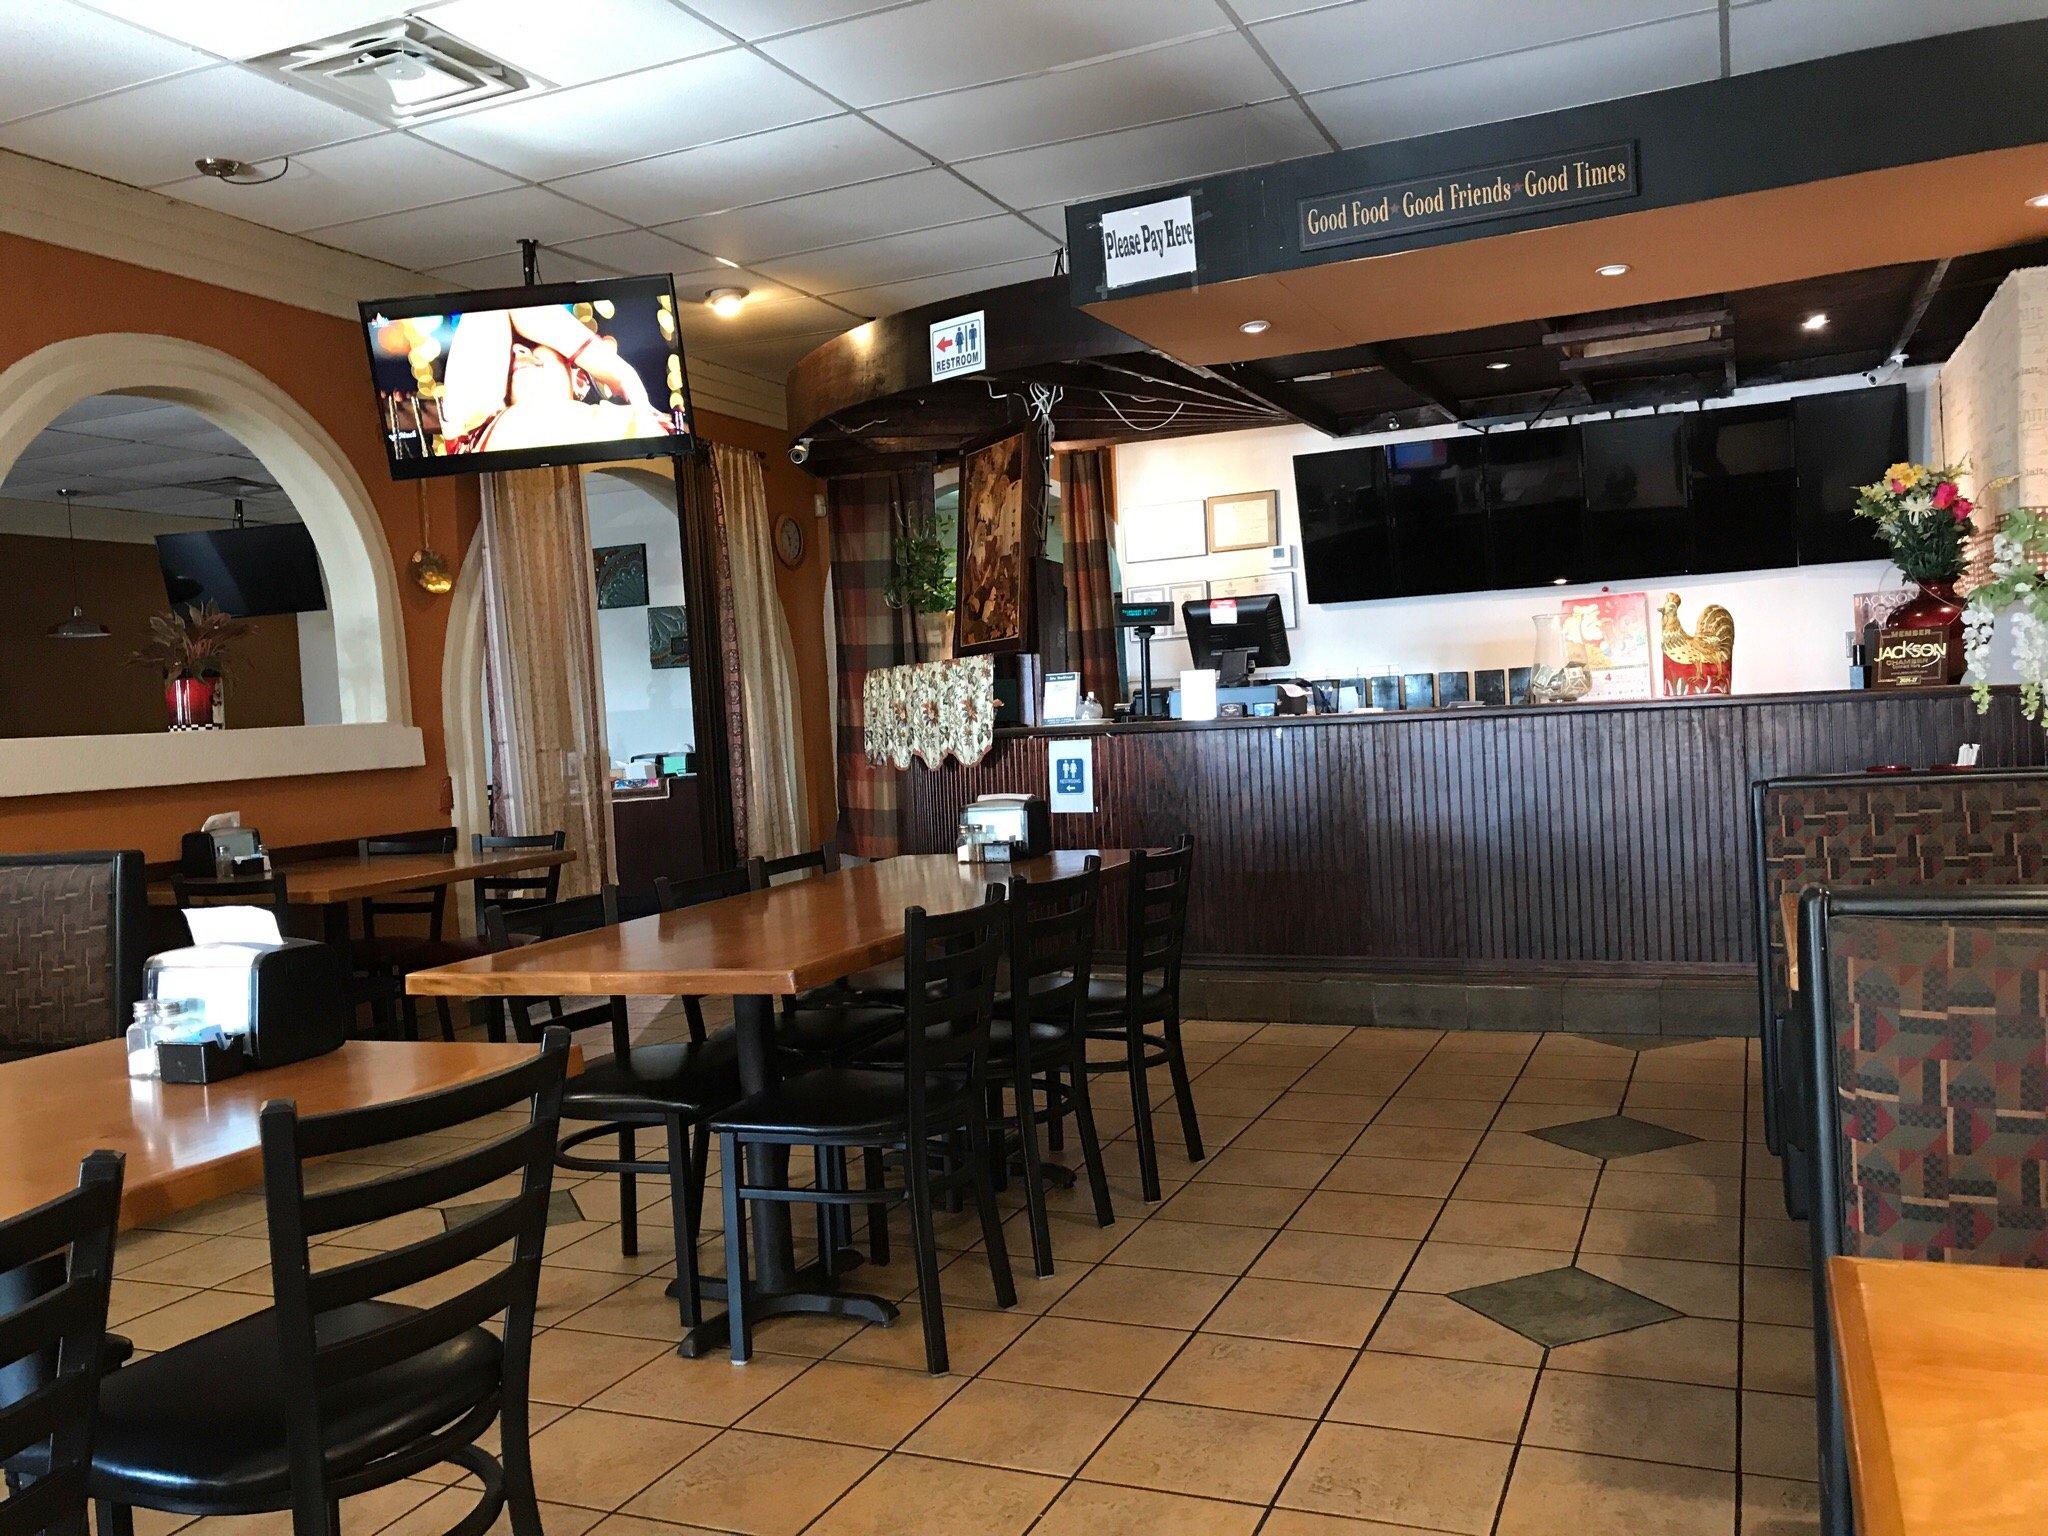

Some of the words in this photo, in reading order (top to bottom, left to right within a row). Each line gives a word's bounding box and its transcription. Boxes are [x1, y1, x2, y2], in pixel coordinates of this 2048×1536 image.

[1307, 203, 1348, 235] Good
[1351, 196, 1389, 227] Food
[1402, 186, 1444, 218] Good
[1450, 176, 1511, 210] Friends
[1524, 165, 1568, 198] Good
[1573, 161, 1626, 189] Times
[1105, 229, 1142, 260] Please
[1140, 224, 1164, 258] Pay
[1163, 219, 1193, 248] Here
[936, 352, 979, 372] RESTROOM
[1890, 628, 1931, 638] MEMBER
[1605, 673, 1612, 682] 4
